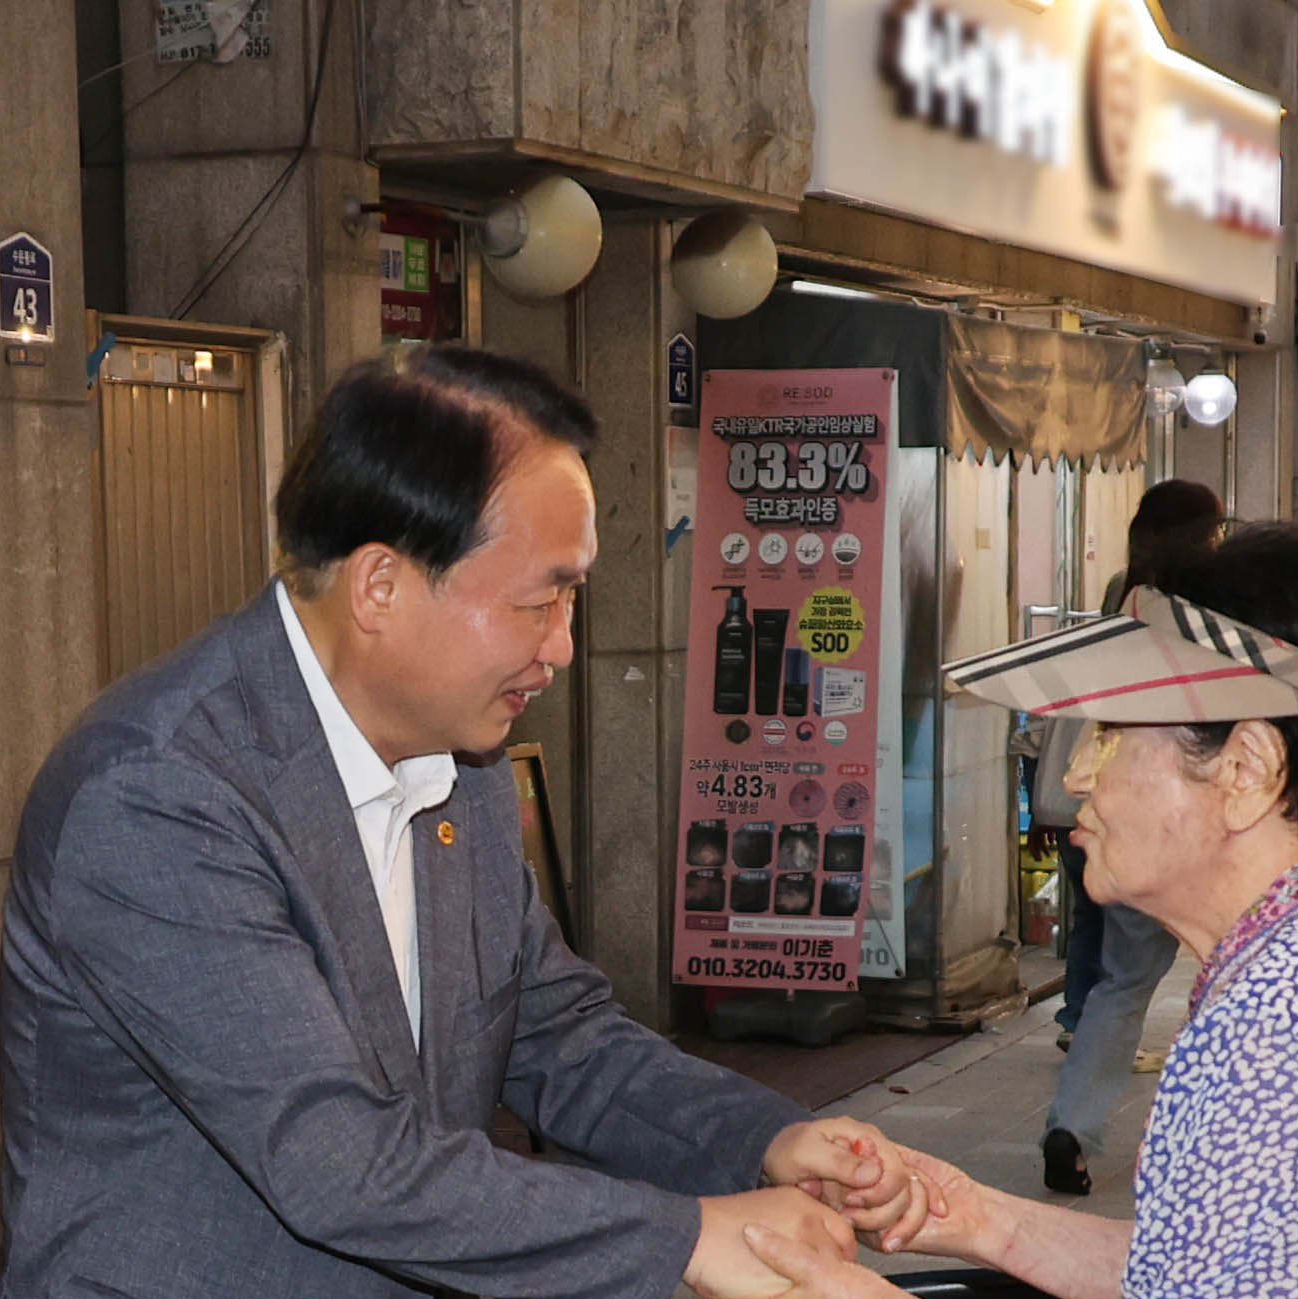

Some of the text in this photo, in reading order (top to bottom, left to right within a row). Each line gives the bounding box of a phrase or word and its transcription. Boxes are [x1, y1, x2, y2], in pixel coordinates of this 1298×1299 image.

[13, 287, 38, 325] 43
[674, 371, 688, 398] 45
[728, 441, 868, 493] 83.3%
[744, 498, 838, 523] 득모효과인증
[811, 632, 850, 653] SOD
[782, 938, 834, 958] 이기춘
[687, 956, 847, 982] 010.3204.3730
